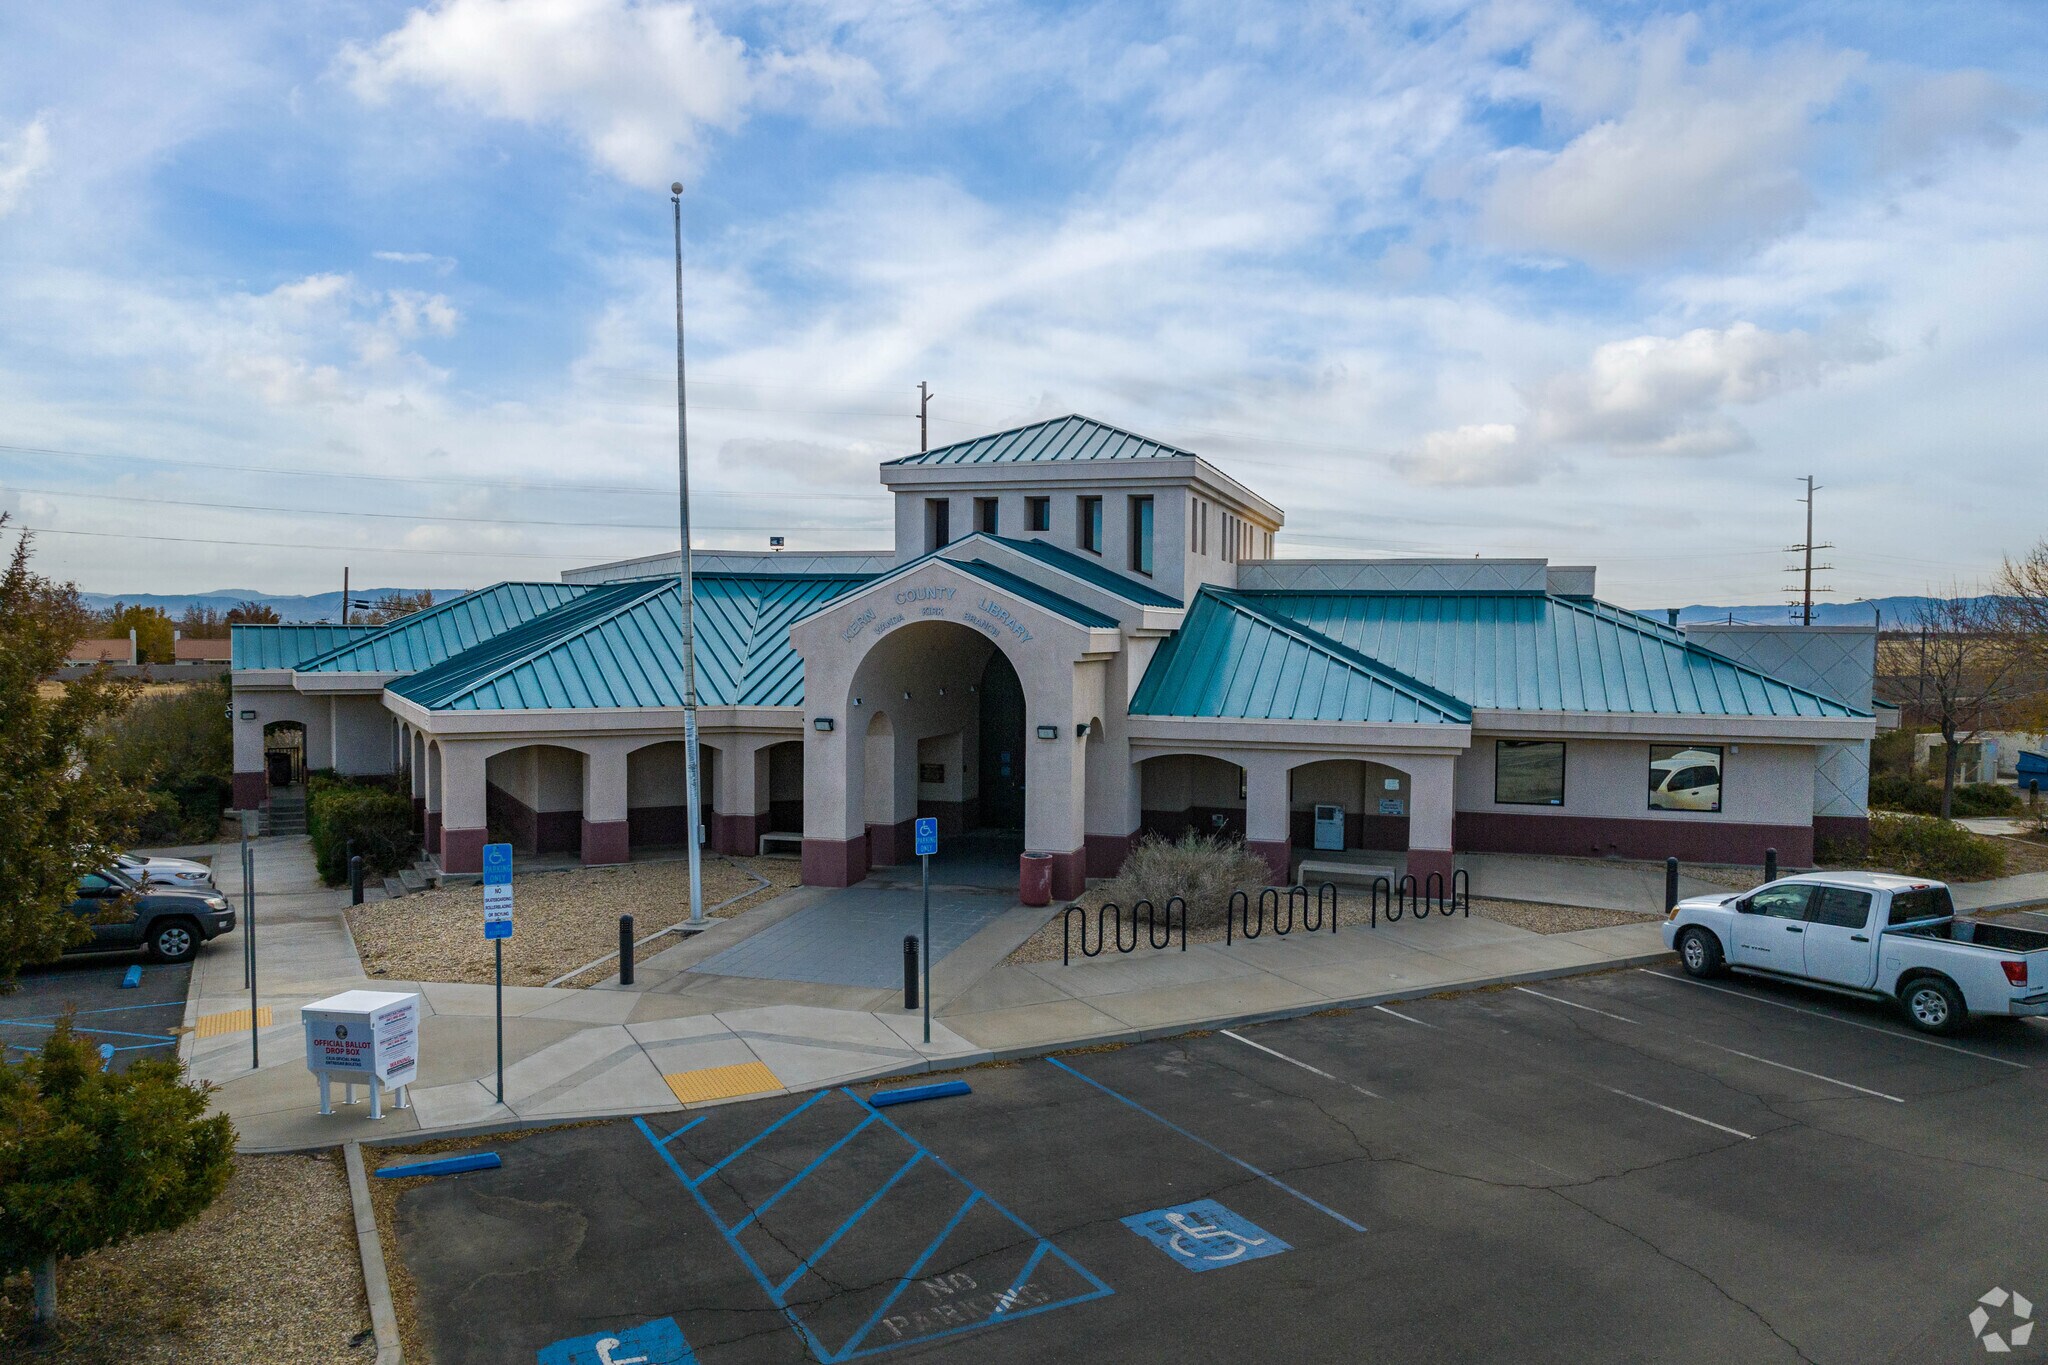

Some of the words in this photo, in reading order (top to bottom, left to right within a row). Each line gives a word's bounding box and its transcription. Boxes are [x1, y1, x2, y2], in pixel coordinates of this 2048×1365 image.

[841, 608, 876, 643] KERN
[895, 587, 957, 605] COUNTY
[978, 597, 1034, 644] LIBRARY
[873, 614, 905, 636] WANDA
[921, 607, 944, 616] KIRK
[963, 612, 1000, 638] BRANCH
[485, 864, 511, 873] PARKING
[490, 874, 506, 882] ONLY
[345, 1041, 371, 1049] BALLOT
[920, 1272, 977, 1298] NO
